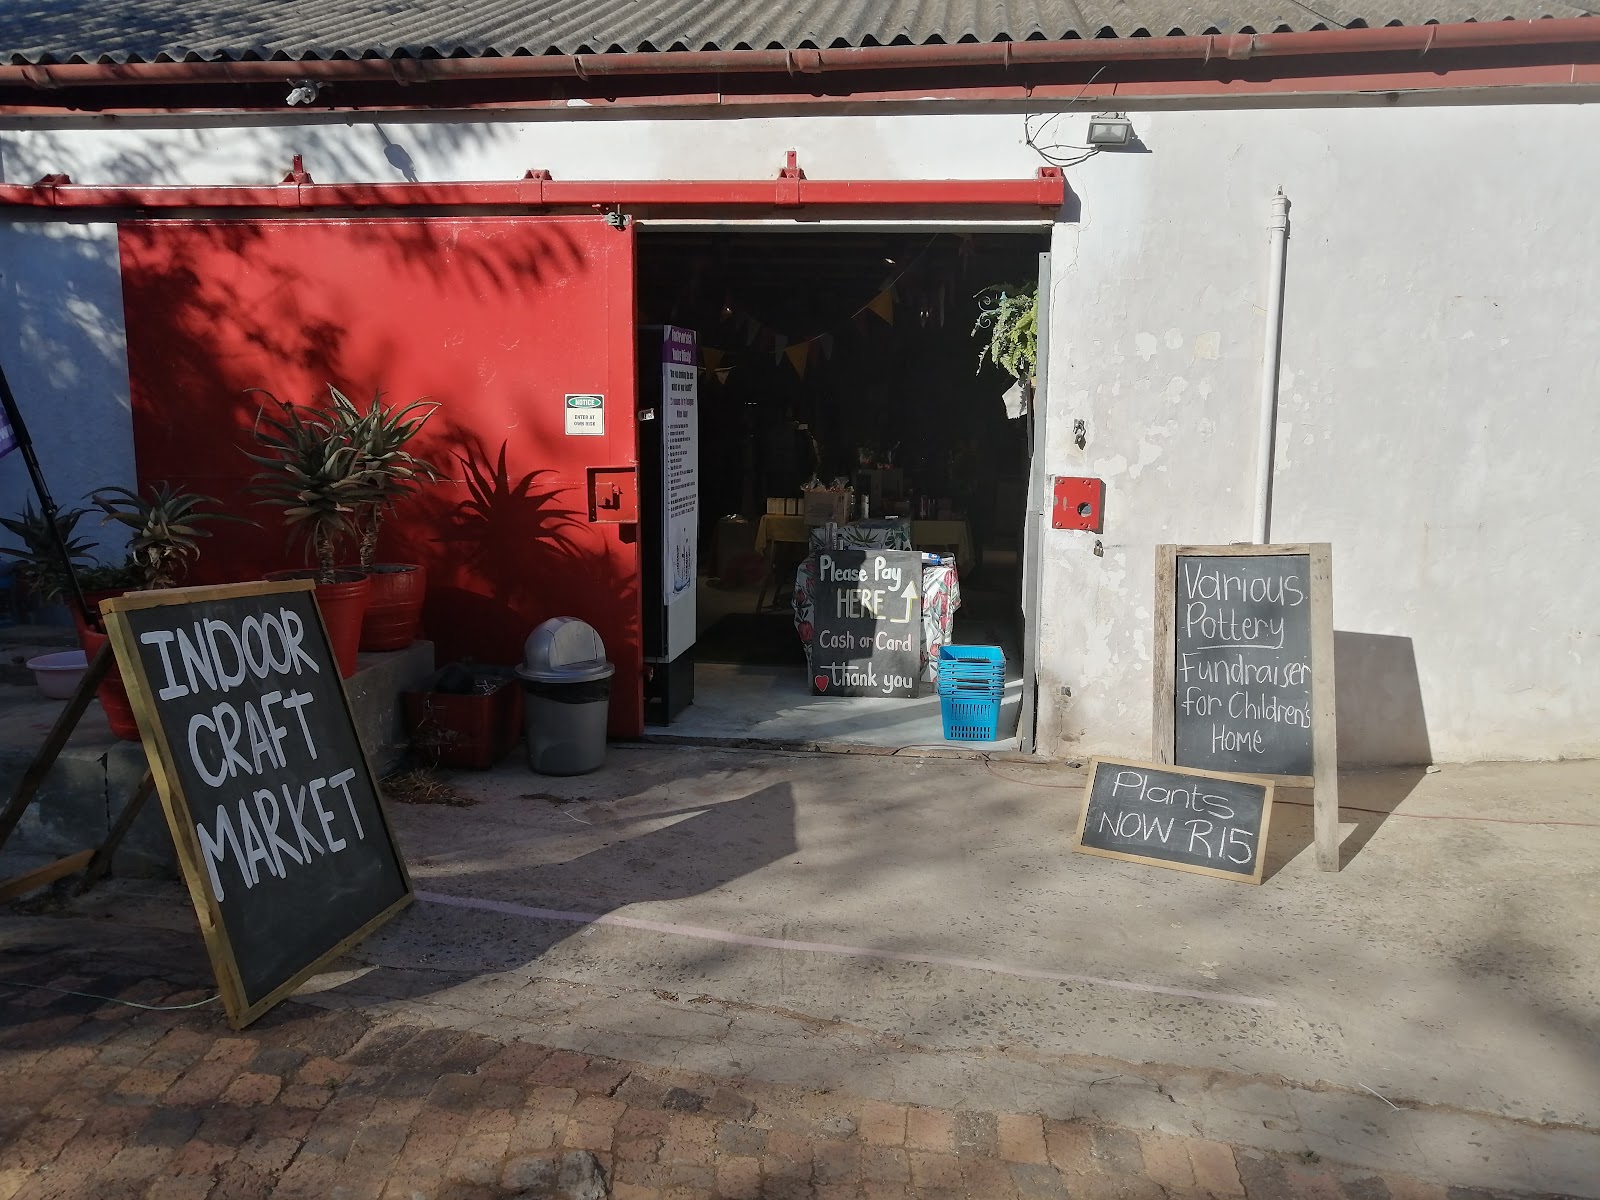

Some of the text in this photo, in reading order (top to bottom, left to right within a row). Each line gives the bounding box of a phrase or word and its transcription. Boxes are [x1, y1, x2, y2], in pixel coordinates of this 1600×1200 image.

[575, 398, 595, 406] NOTICE
[819, 554, 902, 592] Please Pay
[1184, 562, 1304, 606] Various
[836, 588, 887, 620] HERE
[1186, 601, 1285, 650] Pottery
[140, 606, 320, 701] INDOOR
[819, 629, 912, 652] Cash or Card
[820, 661, 913, 694] thank you
[1179, 652, 1311, 688] Fundraiser
[1181, 686, 1311, 728] for Children's
[188, 688, 318, 788] CRAFT
[1112, 771, 1235, 819] Plants
[196, 767, 365, 903] MARKET
[1098, 811, 1254, 864] NOW R15
